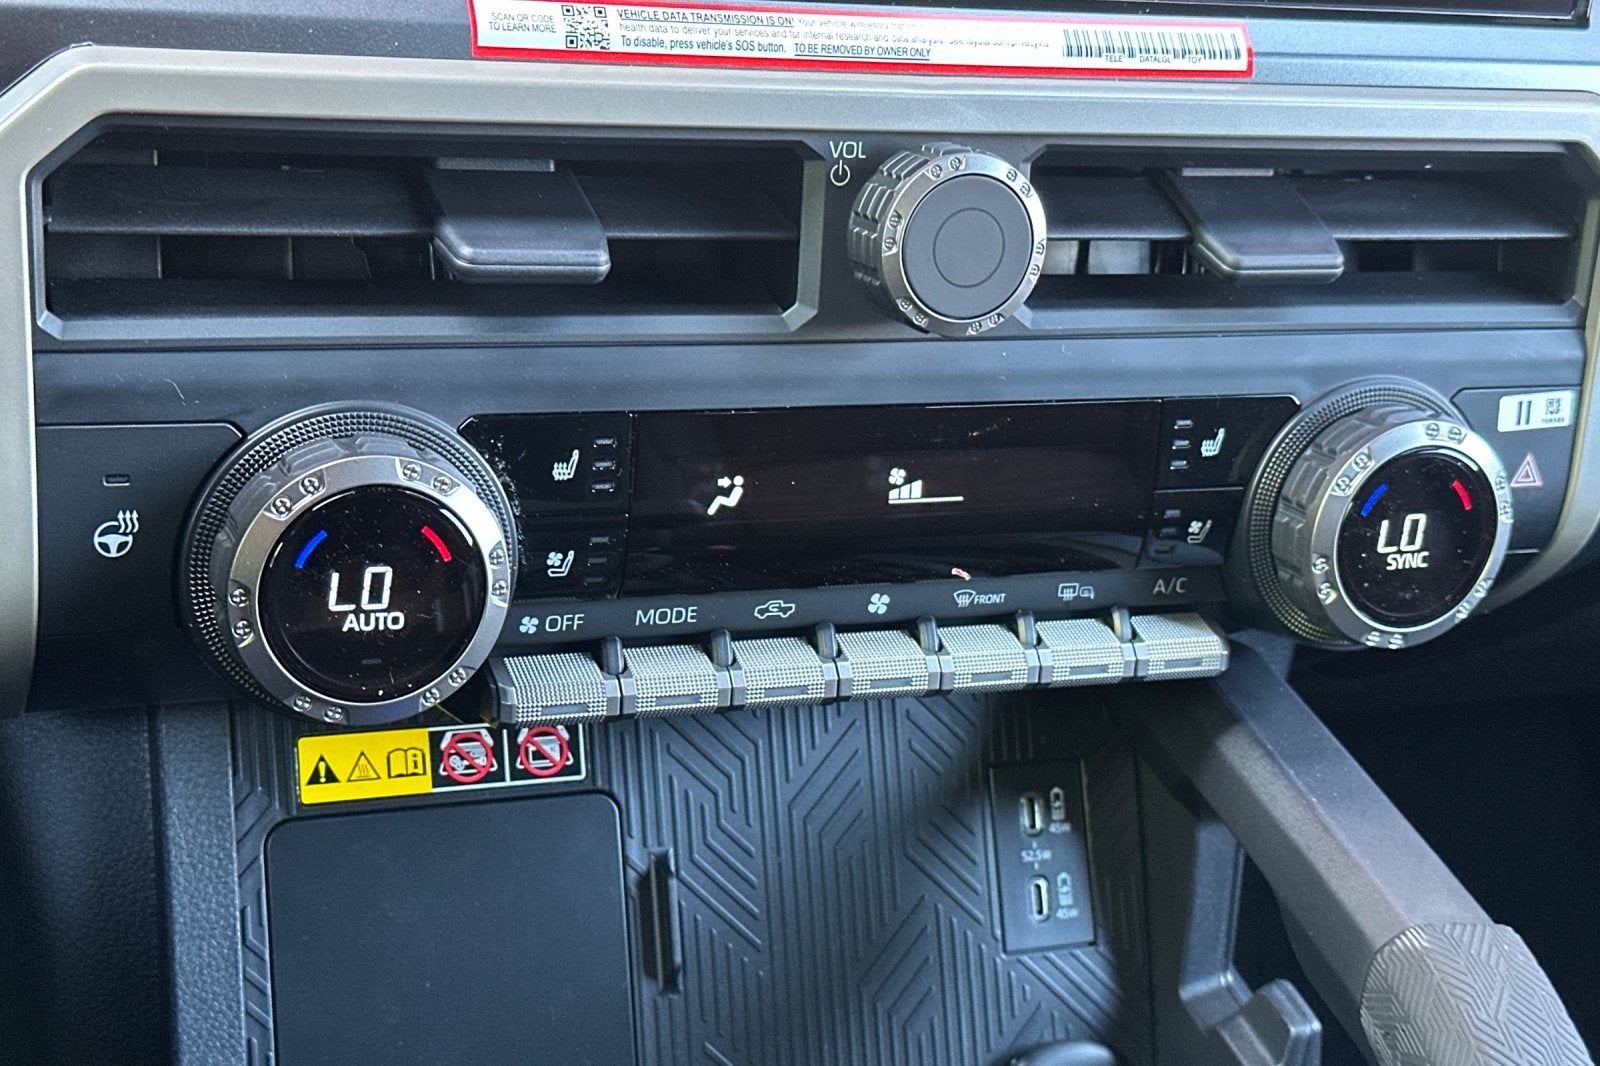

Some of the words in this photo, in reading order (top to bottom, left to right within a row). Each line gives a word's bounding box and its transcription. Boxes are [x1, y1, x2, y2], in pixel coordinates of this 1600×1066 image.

[489, 21, 501, 31] TO
[502, 22, 530, 32] LEARN
[532, 24, 557, 33] MORE
[491, 12, 515, 22] SCAN
[531, 15, 554, 24] CODE
[617, 9, 661, 21] VEHICLE
[662, 11, 689, 22] DATA
[690, 12, 764, 25] TRANSMISSION
[766, 15, 776, 26] IS
[619, 22, 647, 32] health
[649, 24, 669, 33] data
[670, 25, 680, 34] to
[682, 25, 711, 35] deliver
[713, 28, 731, 38] your
[735, 29, 770, 38] services
[772, 30, 788, 39] and
[789, 30, 801, 39] for
[803, 31, 834, 40] internal
[836, 32, 872, 41] research
[874, 34, 889, 42] and
[621, 35, 632, 47] To
[633, 36, 668, 50] disable,
[670, 40, 694, 51] press
[696, 39, 733, 51] vehicle's
[735, 40, 756, 51] SOS
[757, 41, 787, 53] button.
[794, 43, 807, 54] TO
[807, 43, 819, 54] BE
[820, 44, 863, 56] REMOVED
[864, 46, 876, 56] BY
[877, 46, 908, 57] OWNER
[909, 47, 932, 58] ONLY
[1105, 54, 1123, 63] TELE
[1187, 56, 1202, 64] TOY
[829, 140, 866, 159] VOL
[1385, 551, 1430, 571] SYNC
[1152, 576, 1188, 595] A/C
[973, 592, 1007, 606] FRONT
[342, 611, 405, 632] AUTO
[545, 613, 585, 632] OFF
[635, 606, 699, 626] MODE
